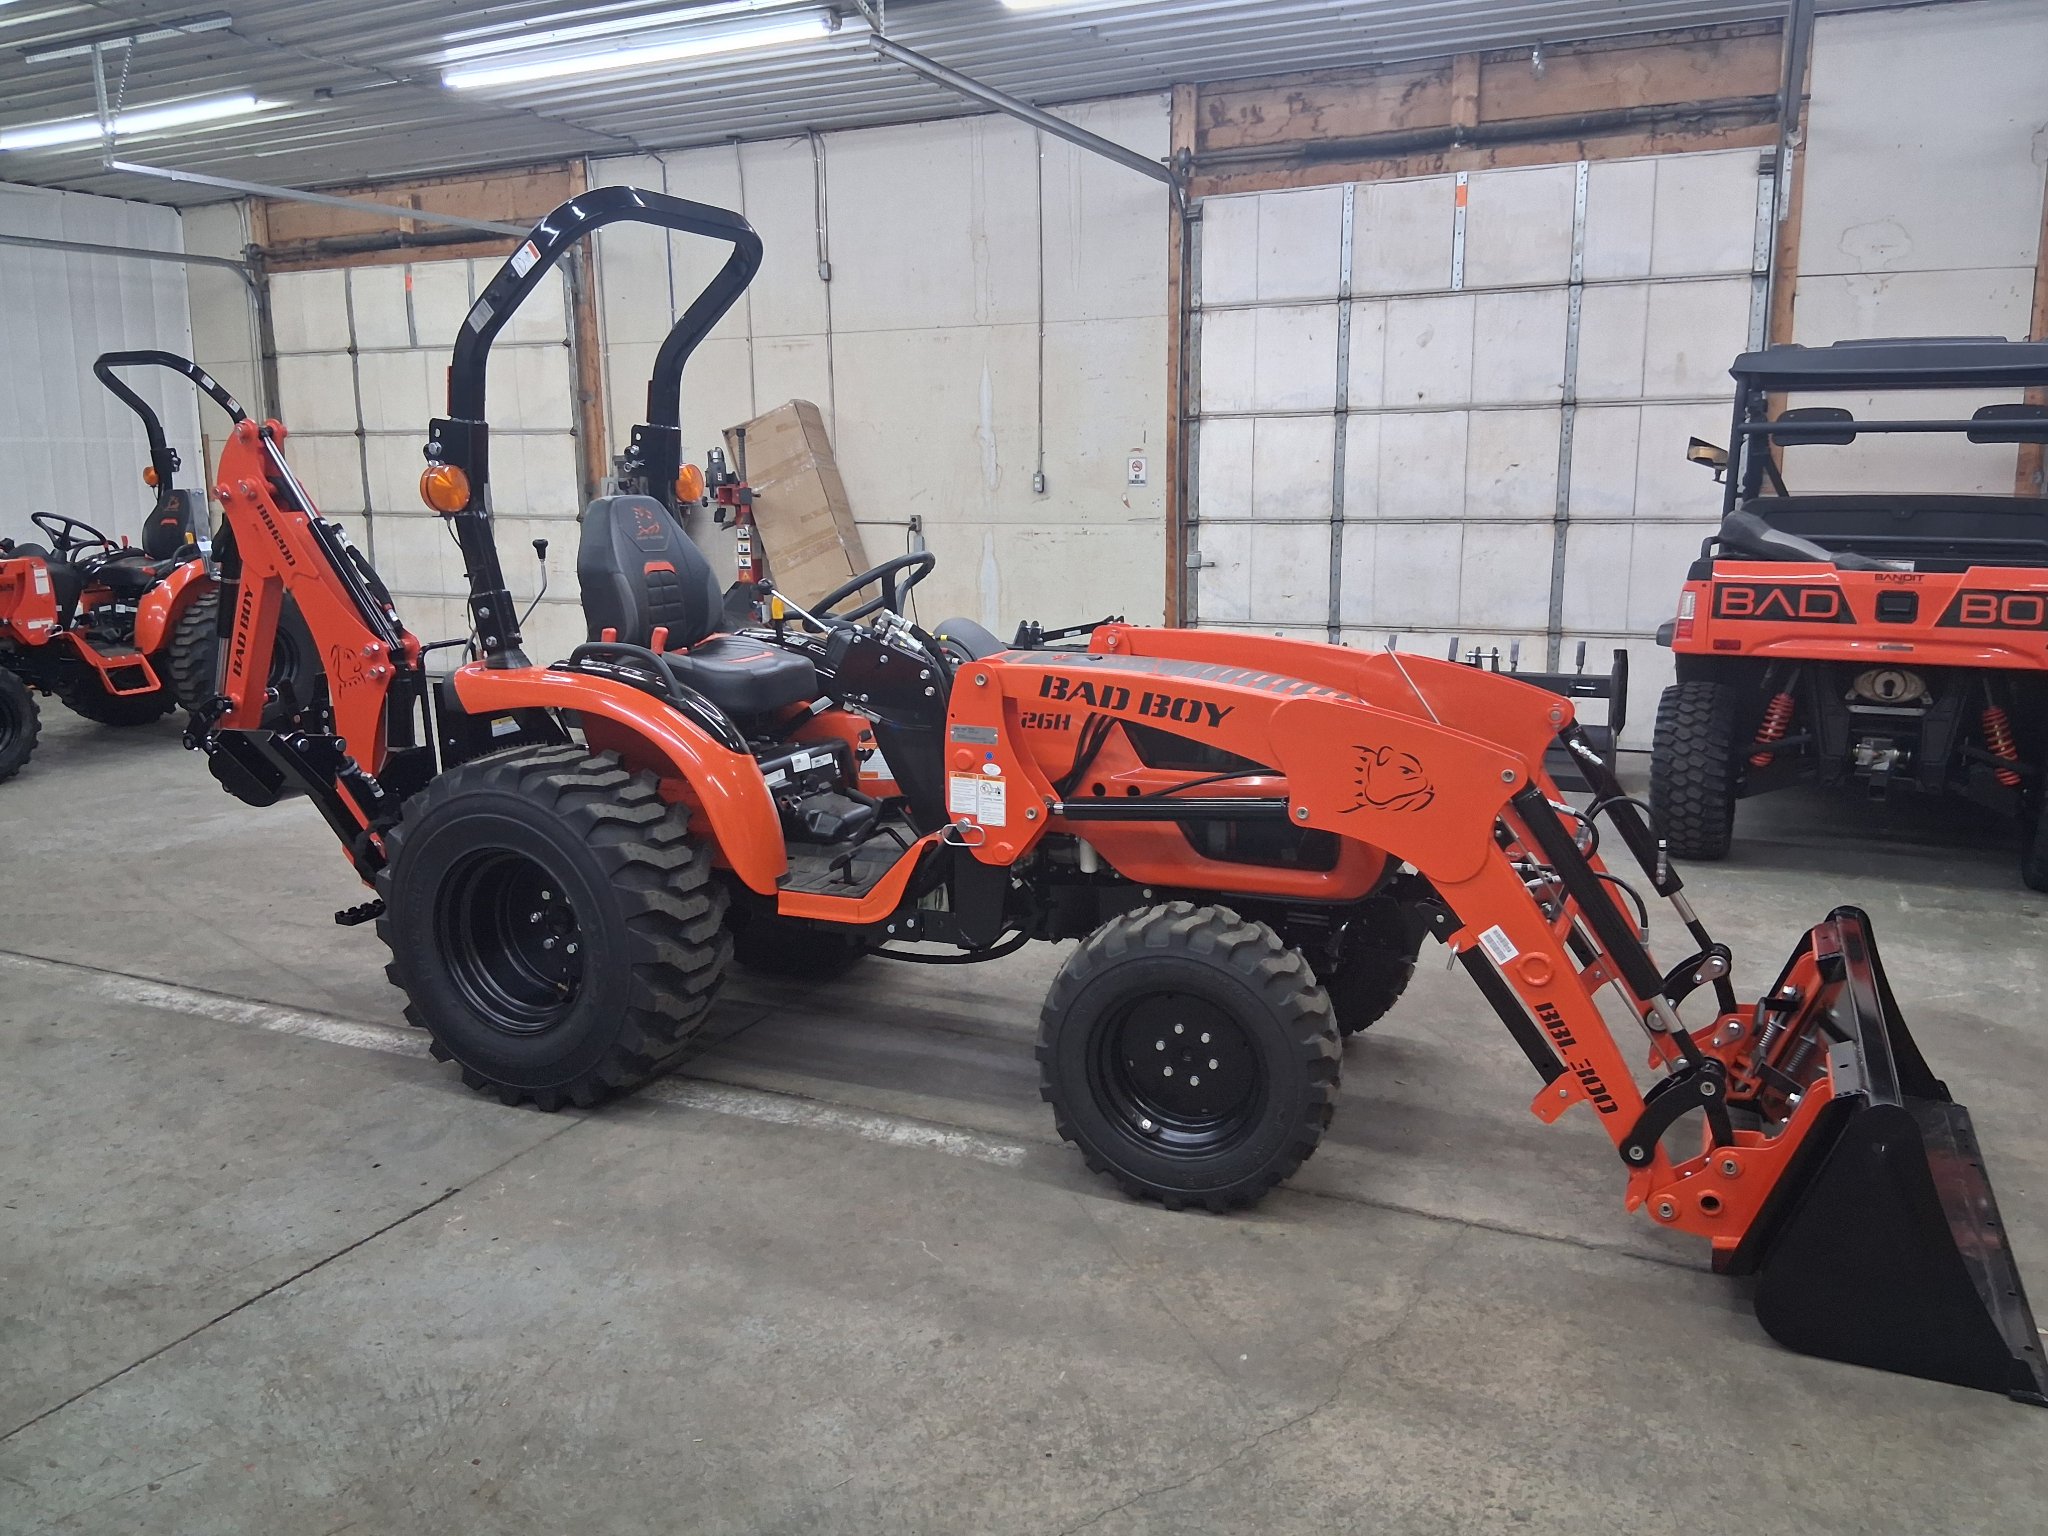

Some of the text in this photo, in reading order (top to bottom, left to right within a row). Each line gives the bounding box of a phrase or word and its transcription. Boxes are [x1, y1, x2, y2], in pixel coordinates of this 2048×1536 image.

[1874, 573, 1925, 582] BANDIT
[1720, 587, 2048, 626] BAD BO
[232, 583, 254, 678] BAD BOY
[1021, 711, 1072, 731] 26H
[1038, 674, 1236, 728] BAD BOY
[1534, 1002, 1618, 1114] BBL 300
